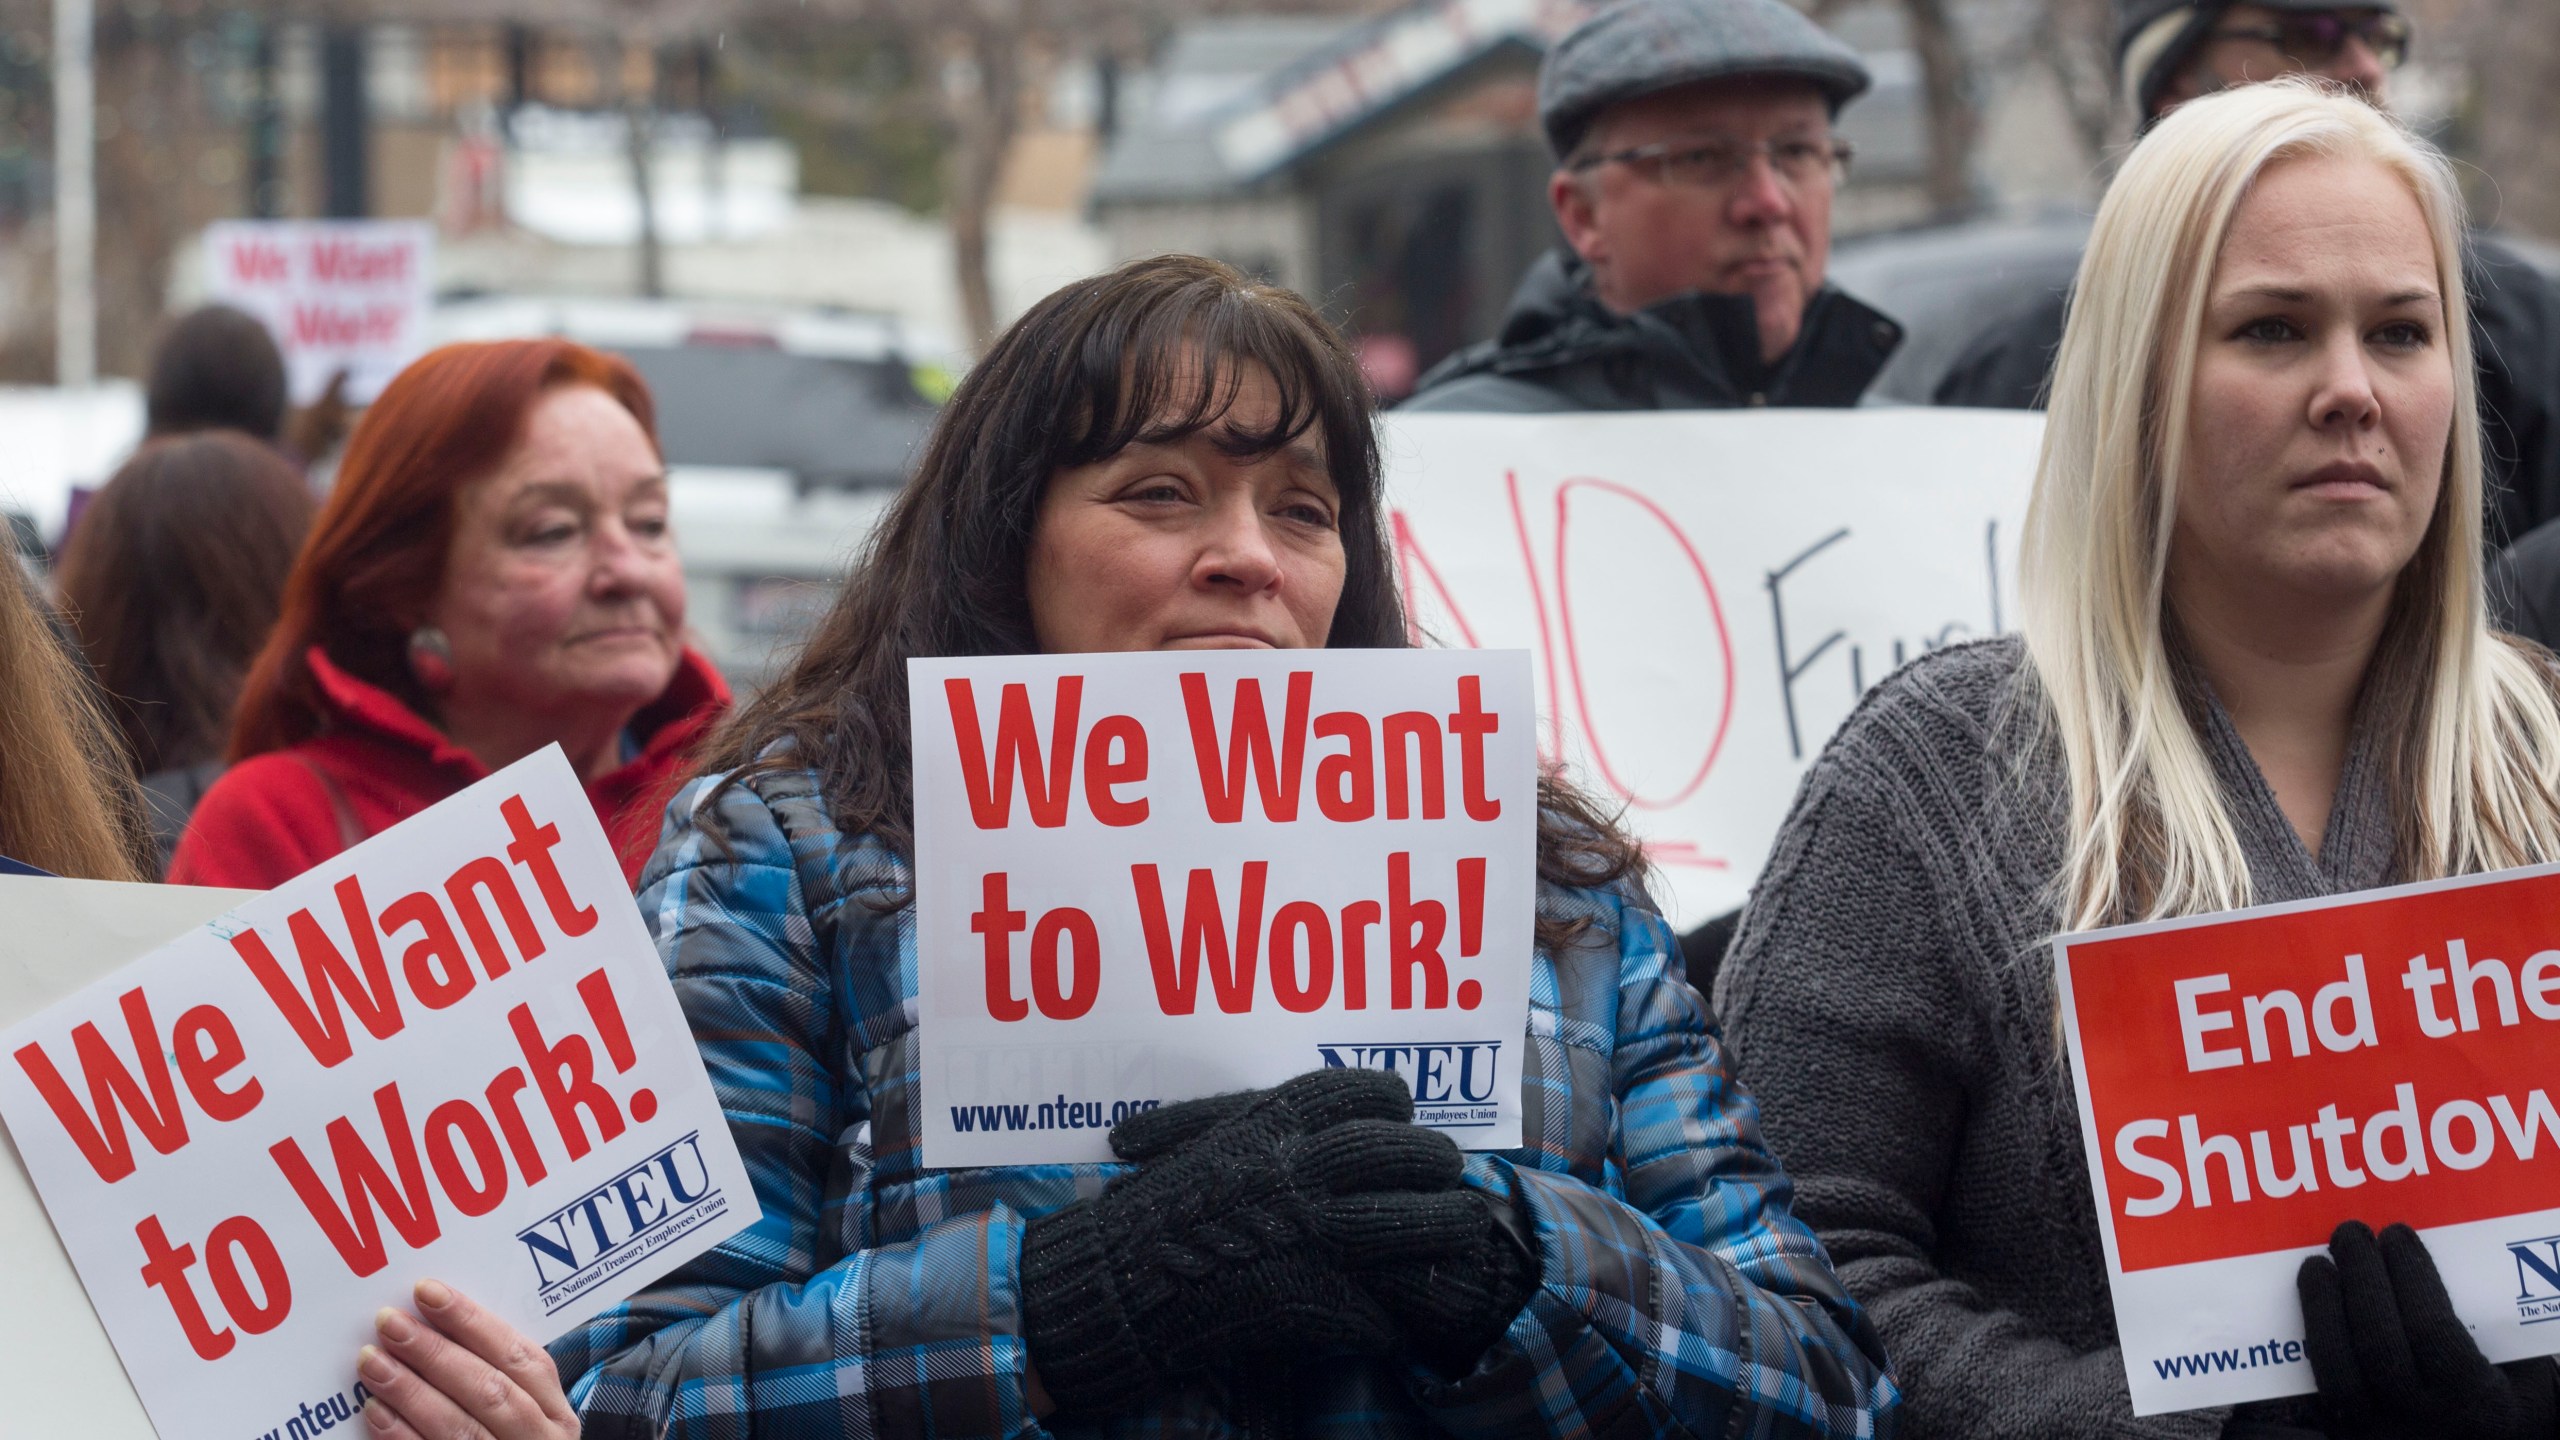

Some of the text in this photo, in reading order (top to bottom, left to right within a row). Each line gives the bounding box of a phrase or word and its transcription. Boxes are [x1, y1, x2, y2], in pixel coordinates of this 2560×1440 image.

[945, 671, 1501, 829] We Want
[13, 795, 599, 1183] We Want
[971, 851, 1487, 1022] to Work!
[2174, 938, 2560, 1073] End the
[135, 968, 658, 1361] to Work!
[1420, 1109, 1468, 1123] Employees
[1470, 1108, 1498, 1119] Union
[517, 1133, 709, 1291] NTEU
[541, 1197, 727, 1309] The National Treasury Employees Union
[2153, 1338, 2307, 1380] www.nte
[2518, 1305, 2540, 1317] The
